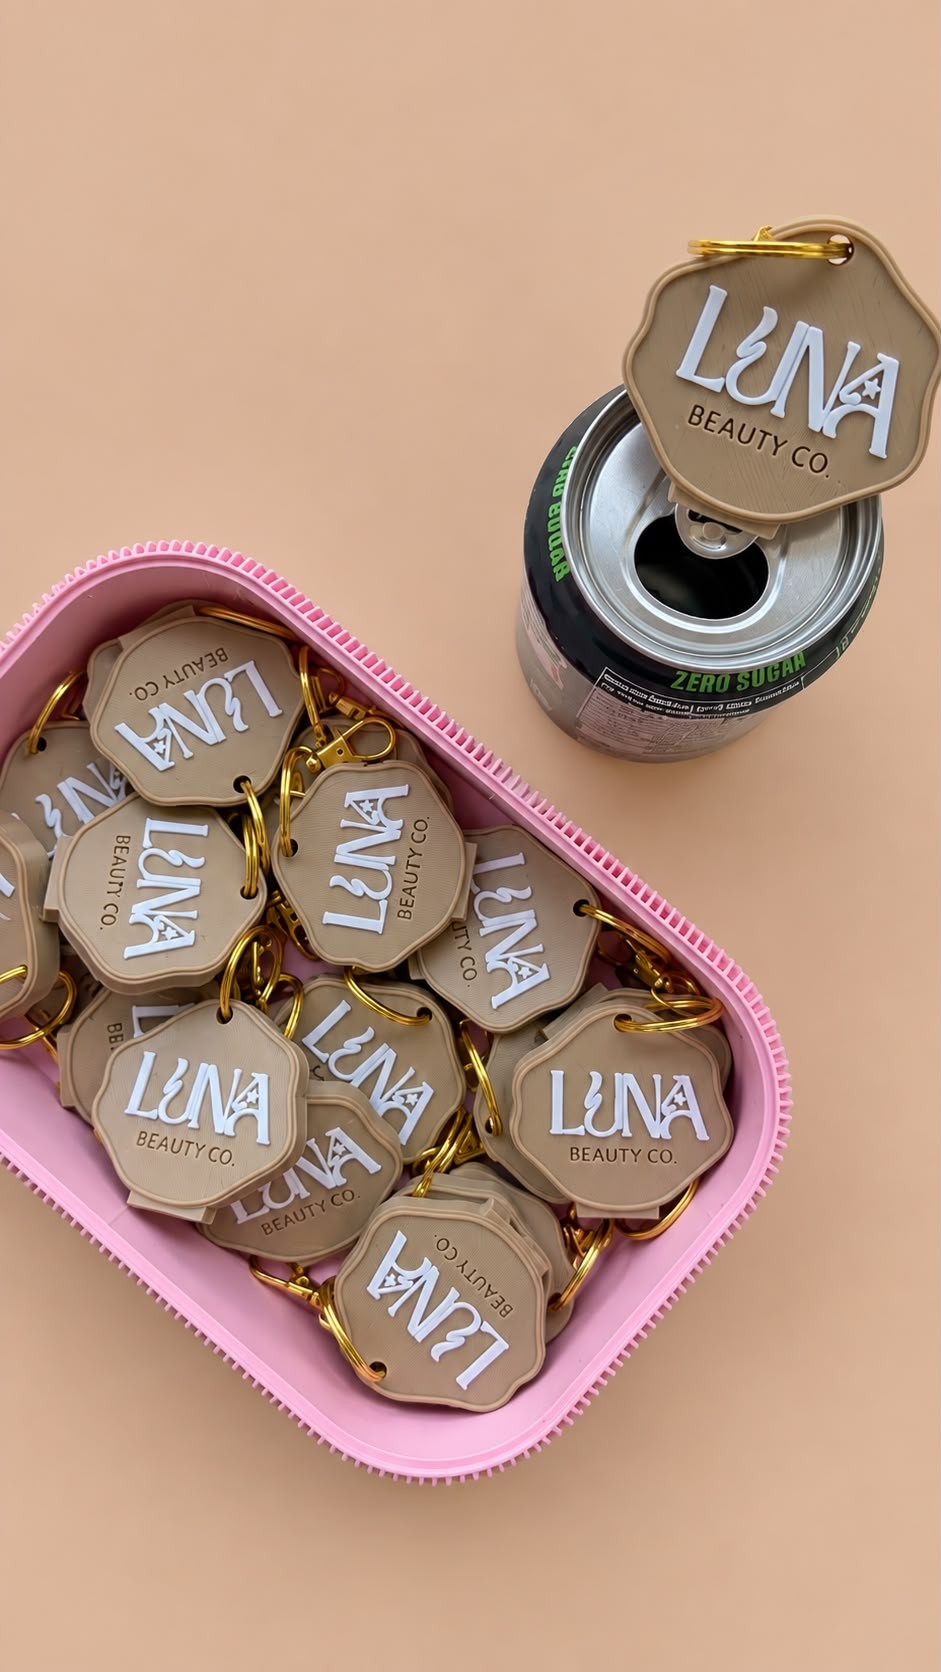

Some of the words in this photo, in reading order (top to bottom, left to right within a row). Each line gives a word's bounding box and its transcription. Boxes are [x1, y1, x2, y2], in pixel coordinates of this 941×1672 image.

[676, 284, 899, 459] LUNA
[687, 404, 788, 456] BEAUTY
[791, 446, 830, 478] CO.
[129, 681, 159, 701] CO.
[163, 647, 229, 689] BEAUTY
[670, 670, 731, 693] ZERO
[736, 650, 807, 692] SUGAR
[114, 660, 283, 771] LUNA
[106, 835, 132, 898] BEAUTY
[123, 818, 208, 960] LUNA
[322, 784, 409, 934] LUNA
[397, 847, 423, 920] BEAUTY
[411, 816, 430, 844] CO.
[100, 903, 119, 930] CO.
[471, 852, 551, 1010] LUNA
[460, 956, 478, 988] CO.
[124, 1051, 270, 1145] LUNA
[302, 1000, 434, 1145] LUNA
[549, 1070, 710, 1141] LUNA
[136, 1131, 206, 1159] BEAUTY
[208, 1147, 235, 1167] CO.
[570, 1147, 642, 1163] BEAUTY
[647, 1149, 677, 1164] CO.
[261, 1200, 326, 1236] BEAUTY
[331, 1189, 361, 1208] CO.
[434, 1234, 458, 1261] CO.
[366, 1230, 510, 1391] LUNA
[456, 1260, 514, 1318] BEAUTY
